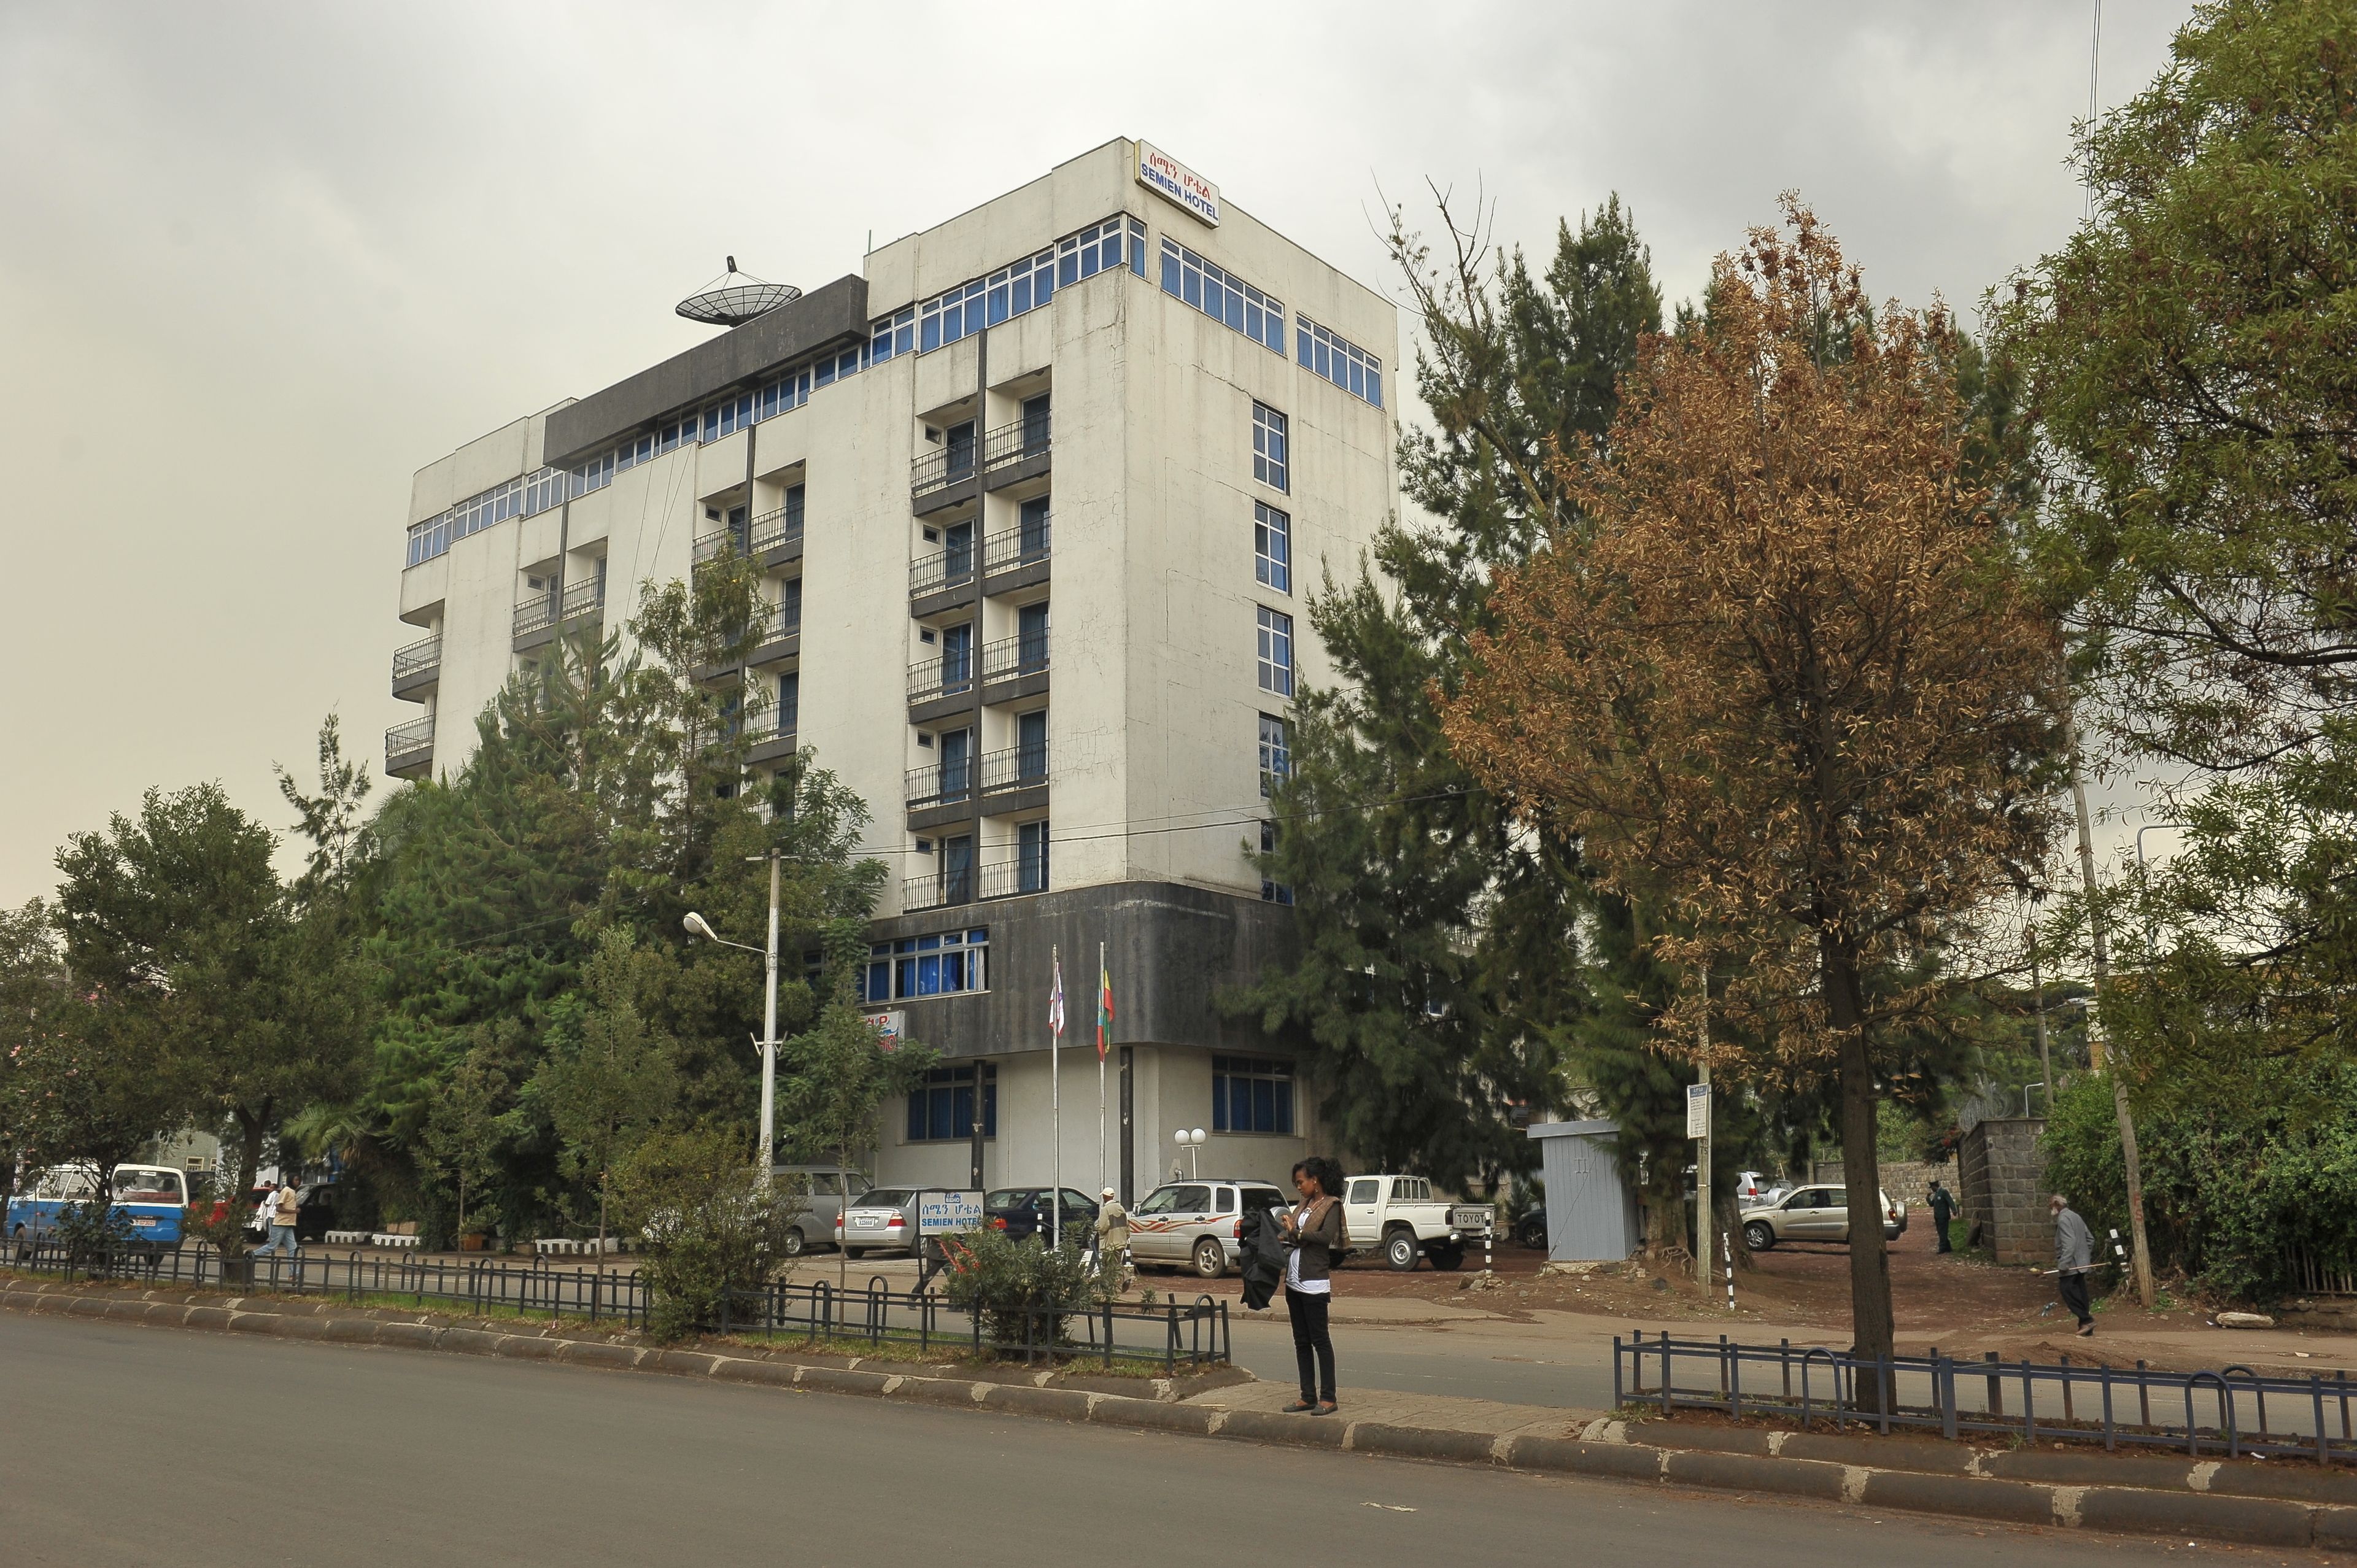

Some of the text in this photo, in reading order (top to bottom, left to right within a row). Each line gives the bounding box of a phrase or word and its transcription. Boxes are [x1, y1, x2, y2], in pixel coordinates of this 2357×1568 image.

[1141, 163, 1218, 221] SEMIEN HOTEL
[922, 1218, 953, 1226] SEMIEN
[1458, 1215, 1486, 1223] TOYOT
